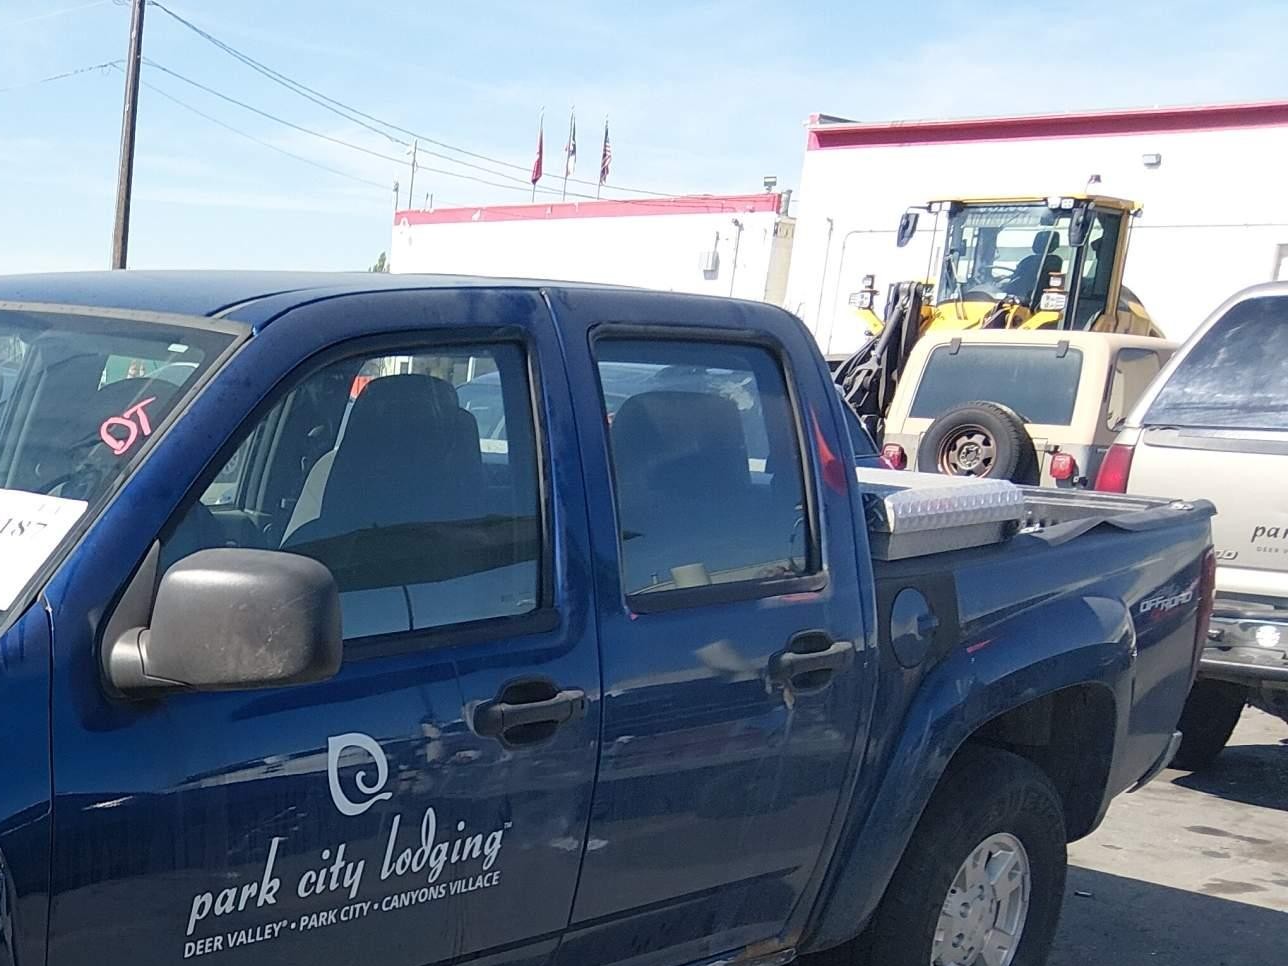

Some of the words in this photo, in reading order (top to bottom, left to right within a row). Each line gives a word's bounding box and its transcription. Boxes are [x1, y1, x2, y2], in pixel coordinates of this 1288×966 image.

[183, 935, 224, 959] DEER
[299, 908, 338, 931] PARK
[340, 901, 372, 921] CITY
[381, 883, 447, 911] CANYONS
[185, 836, 281, 936] park
[297, 843, 365, 899] city
